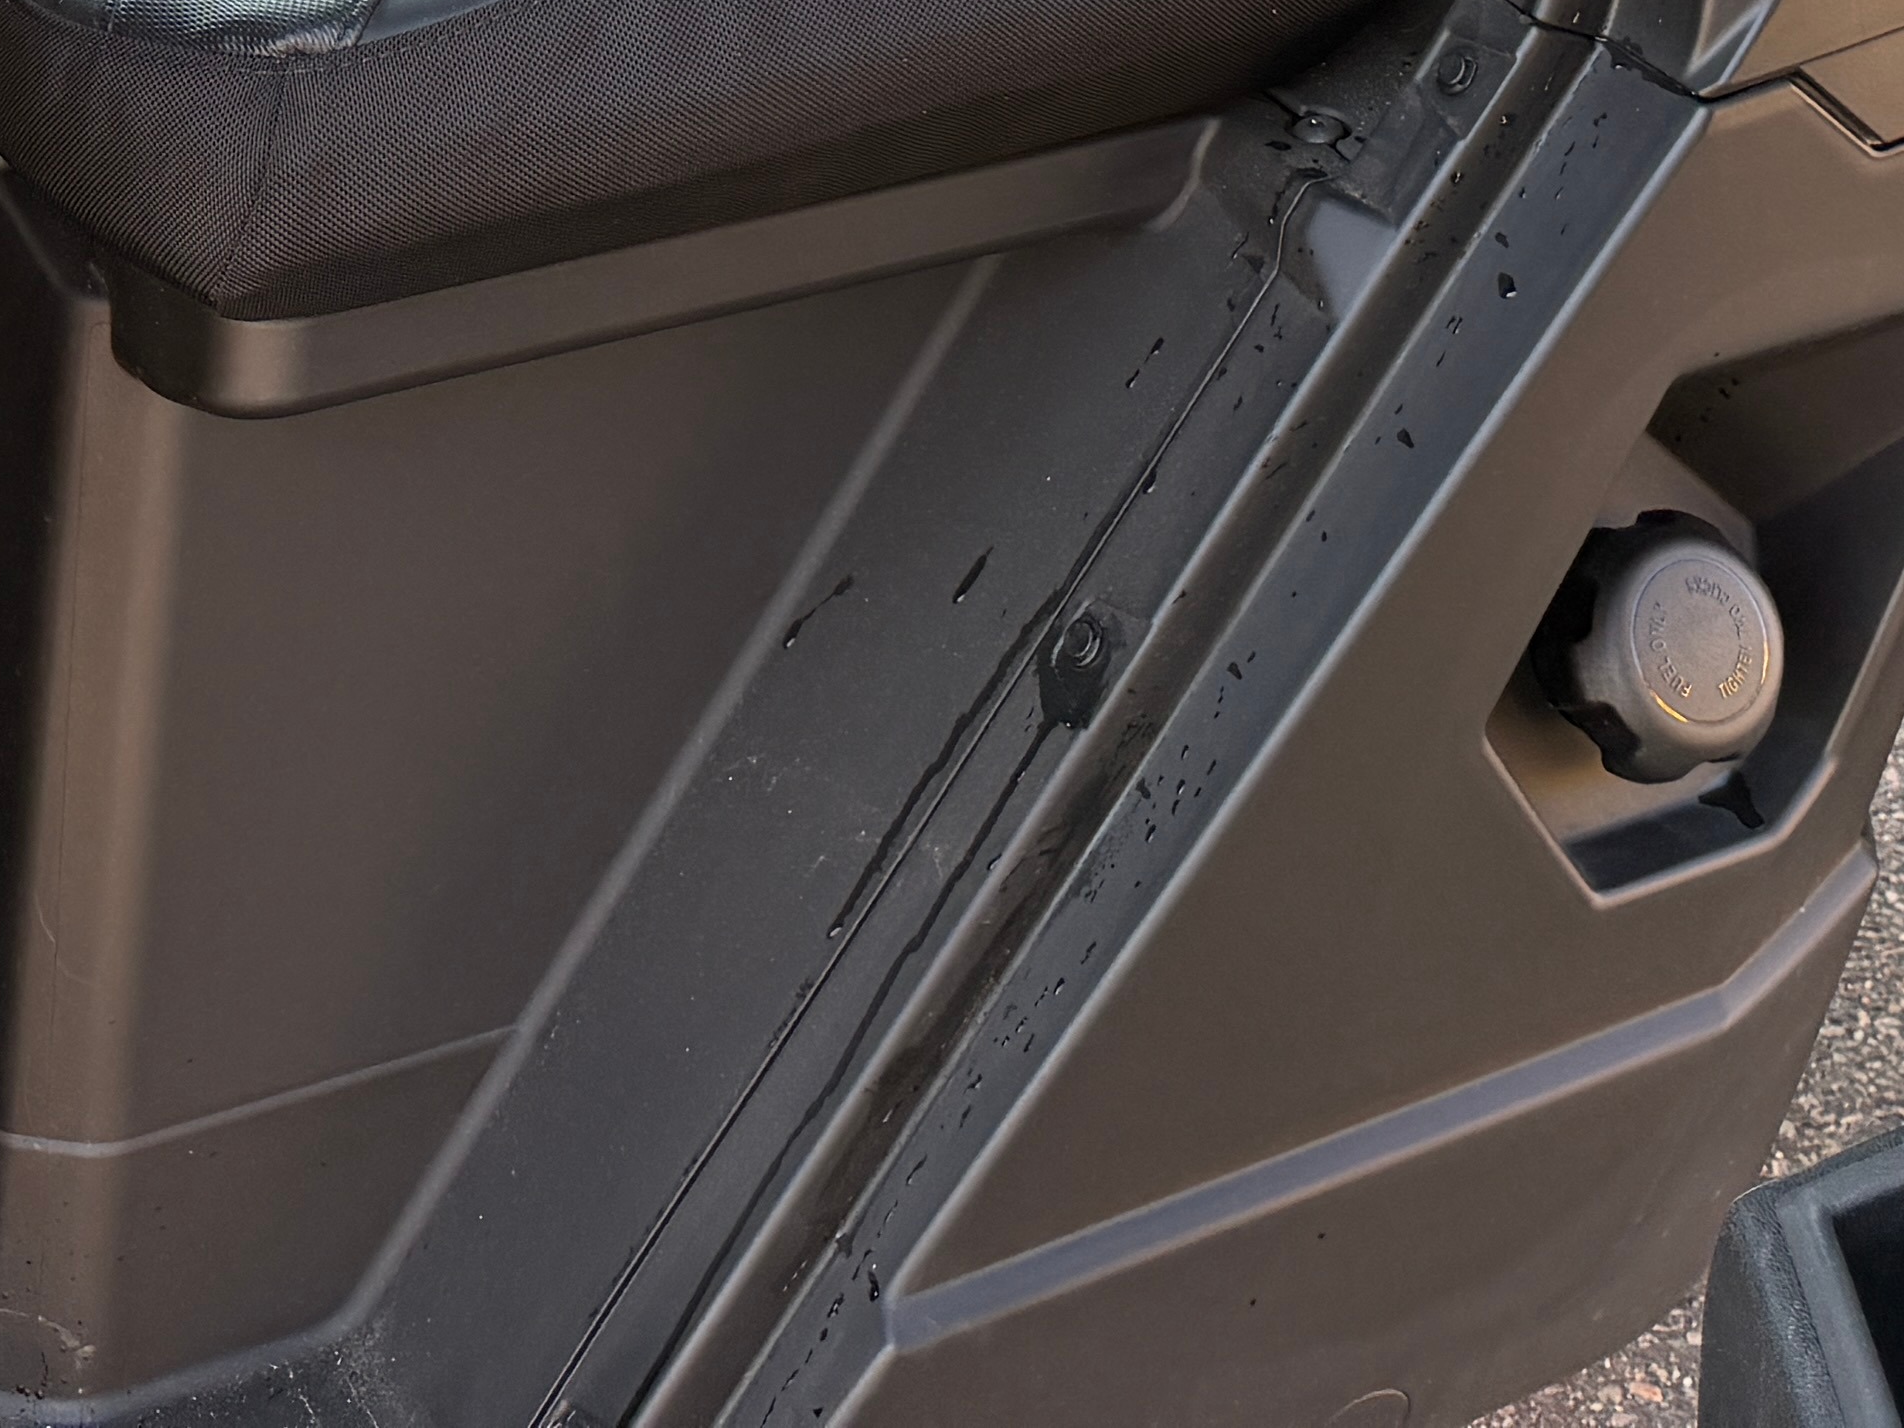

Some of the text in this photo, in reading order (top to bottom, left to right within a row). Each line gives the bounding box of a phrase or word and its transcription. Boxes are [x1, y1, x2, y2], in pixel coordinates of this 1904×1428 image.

[1648, 600, 1693, 698] FUEL ONLY
[1717, 643, 1752, 699] TIGHTEN
